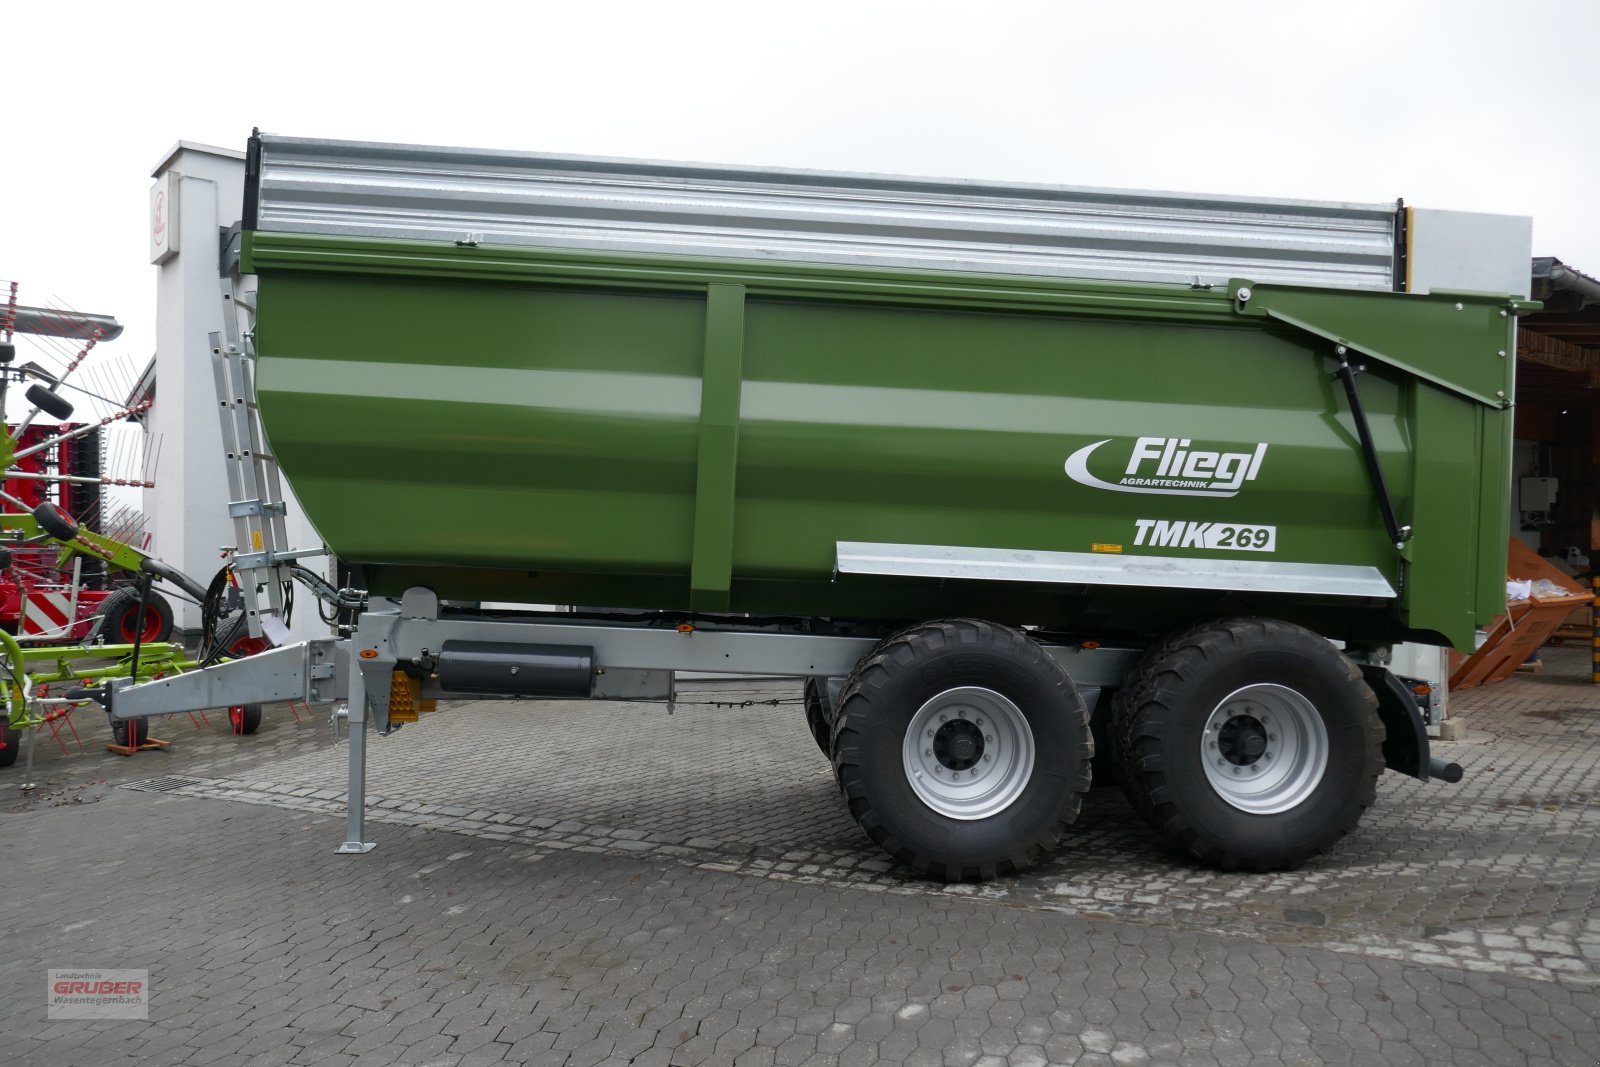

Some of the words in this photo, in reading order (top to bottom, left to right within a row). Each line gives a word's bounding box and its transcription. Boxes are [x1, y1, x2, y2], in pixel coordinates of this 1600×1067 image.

[1125, 436, 1268, 489] Fliegl
[1119, 477, 1210, 489] AGRARTECHNIK
[1133, 519, 1212, 549] TMK
[1217, 527, 1270, 549] 269
